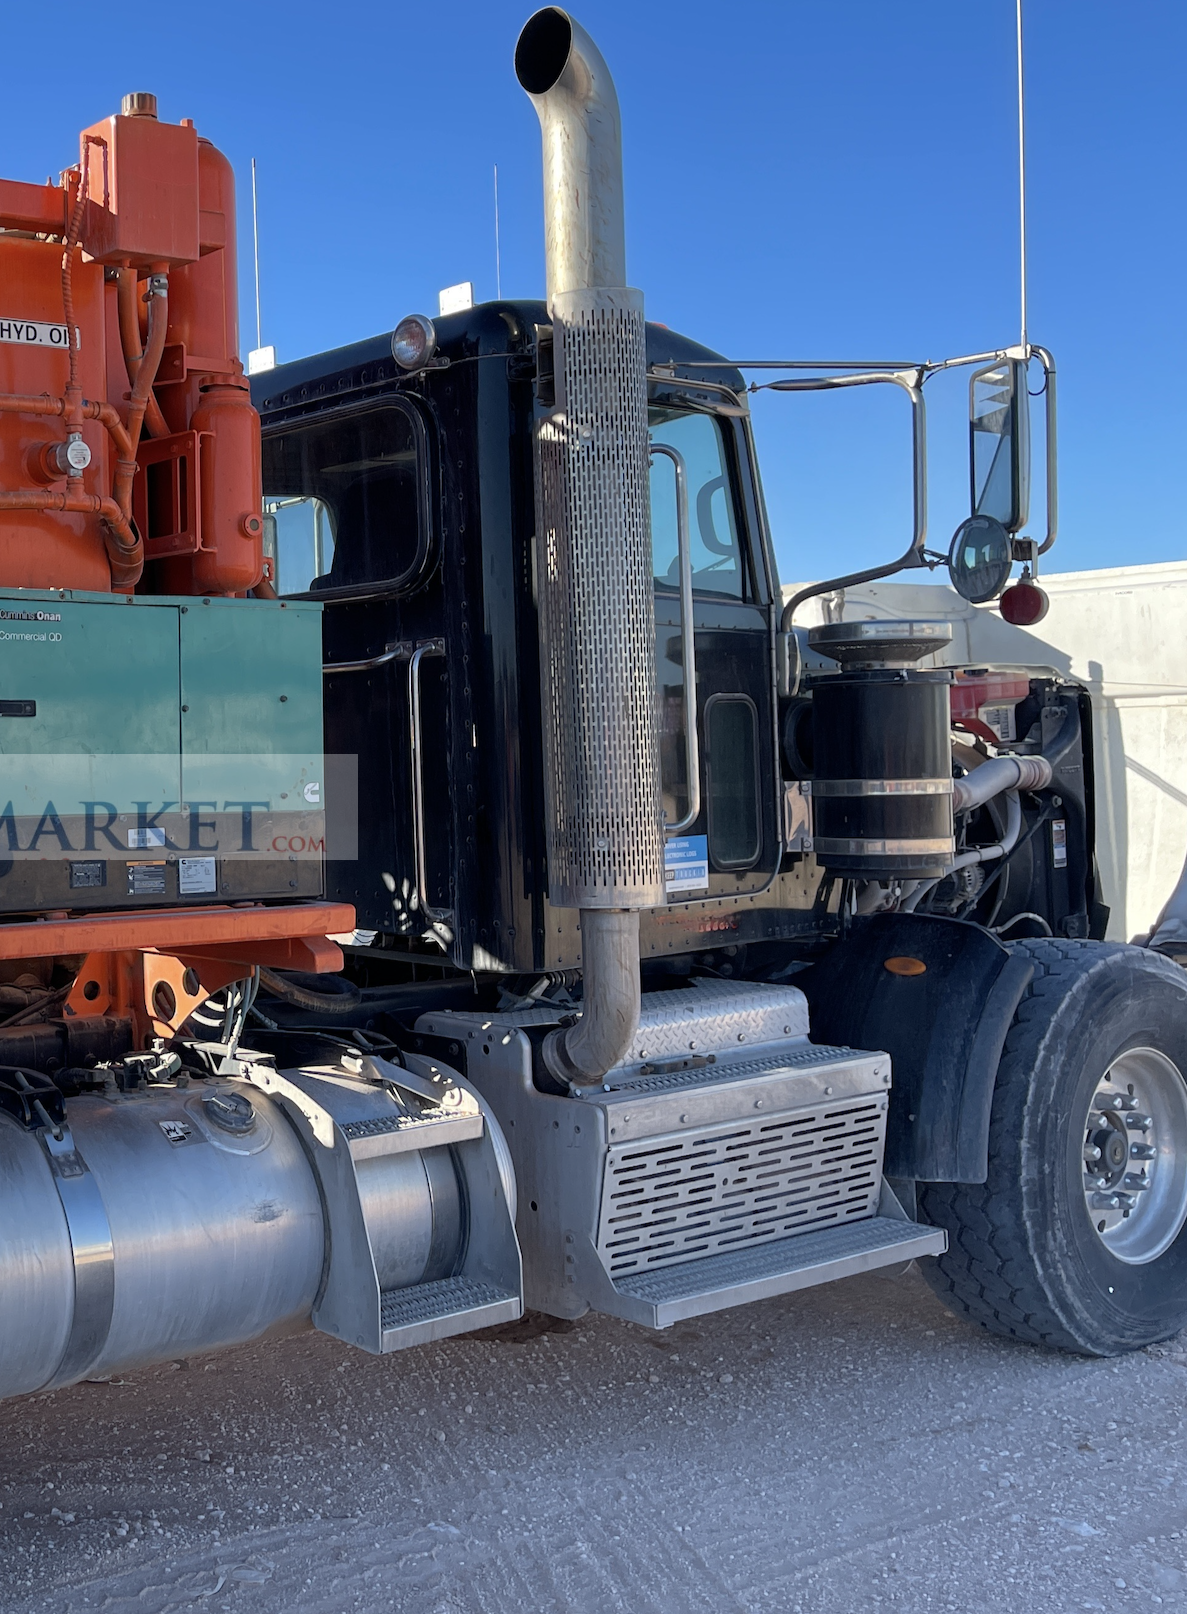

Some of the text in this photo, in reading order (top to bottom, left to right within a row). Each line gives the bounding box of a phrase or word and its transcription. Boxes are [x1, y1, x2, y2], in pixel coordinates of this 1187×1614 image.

[0, 321, 73, 346] HYD. OI
[36, 610, 61, 621] Onan
[48, 632, 62, 642] QD
